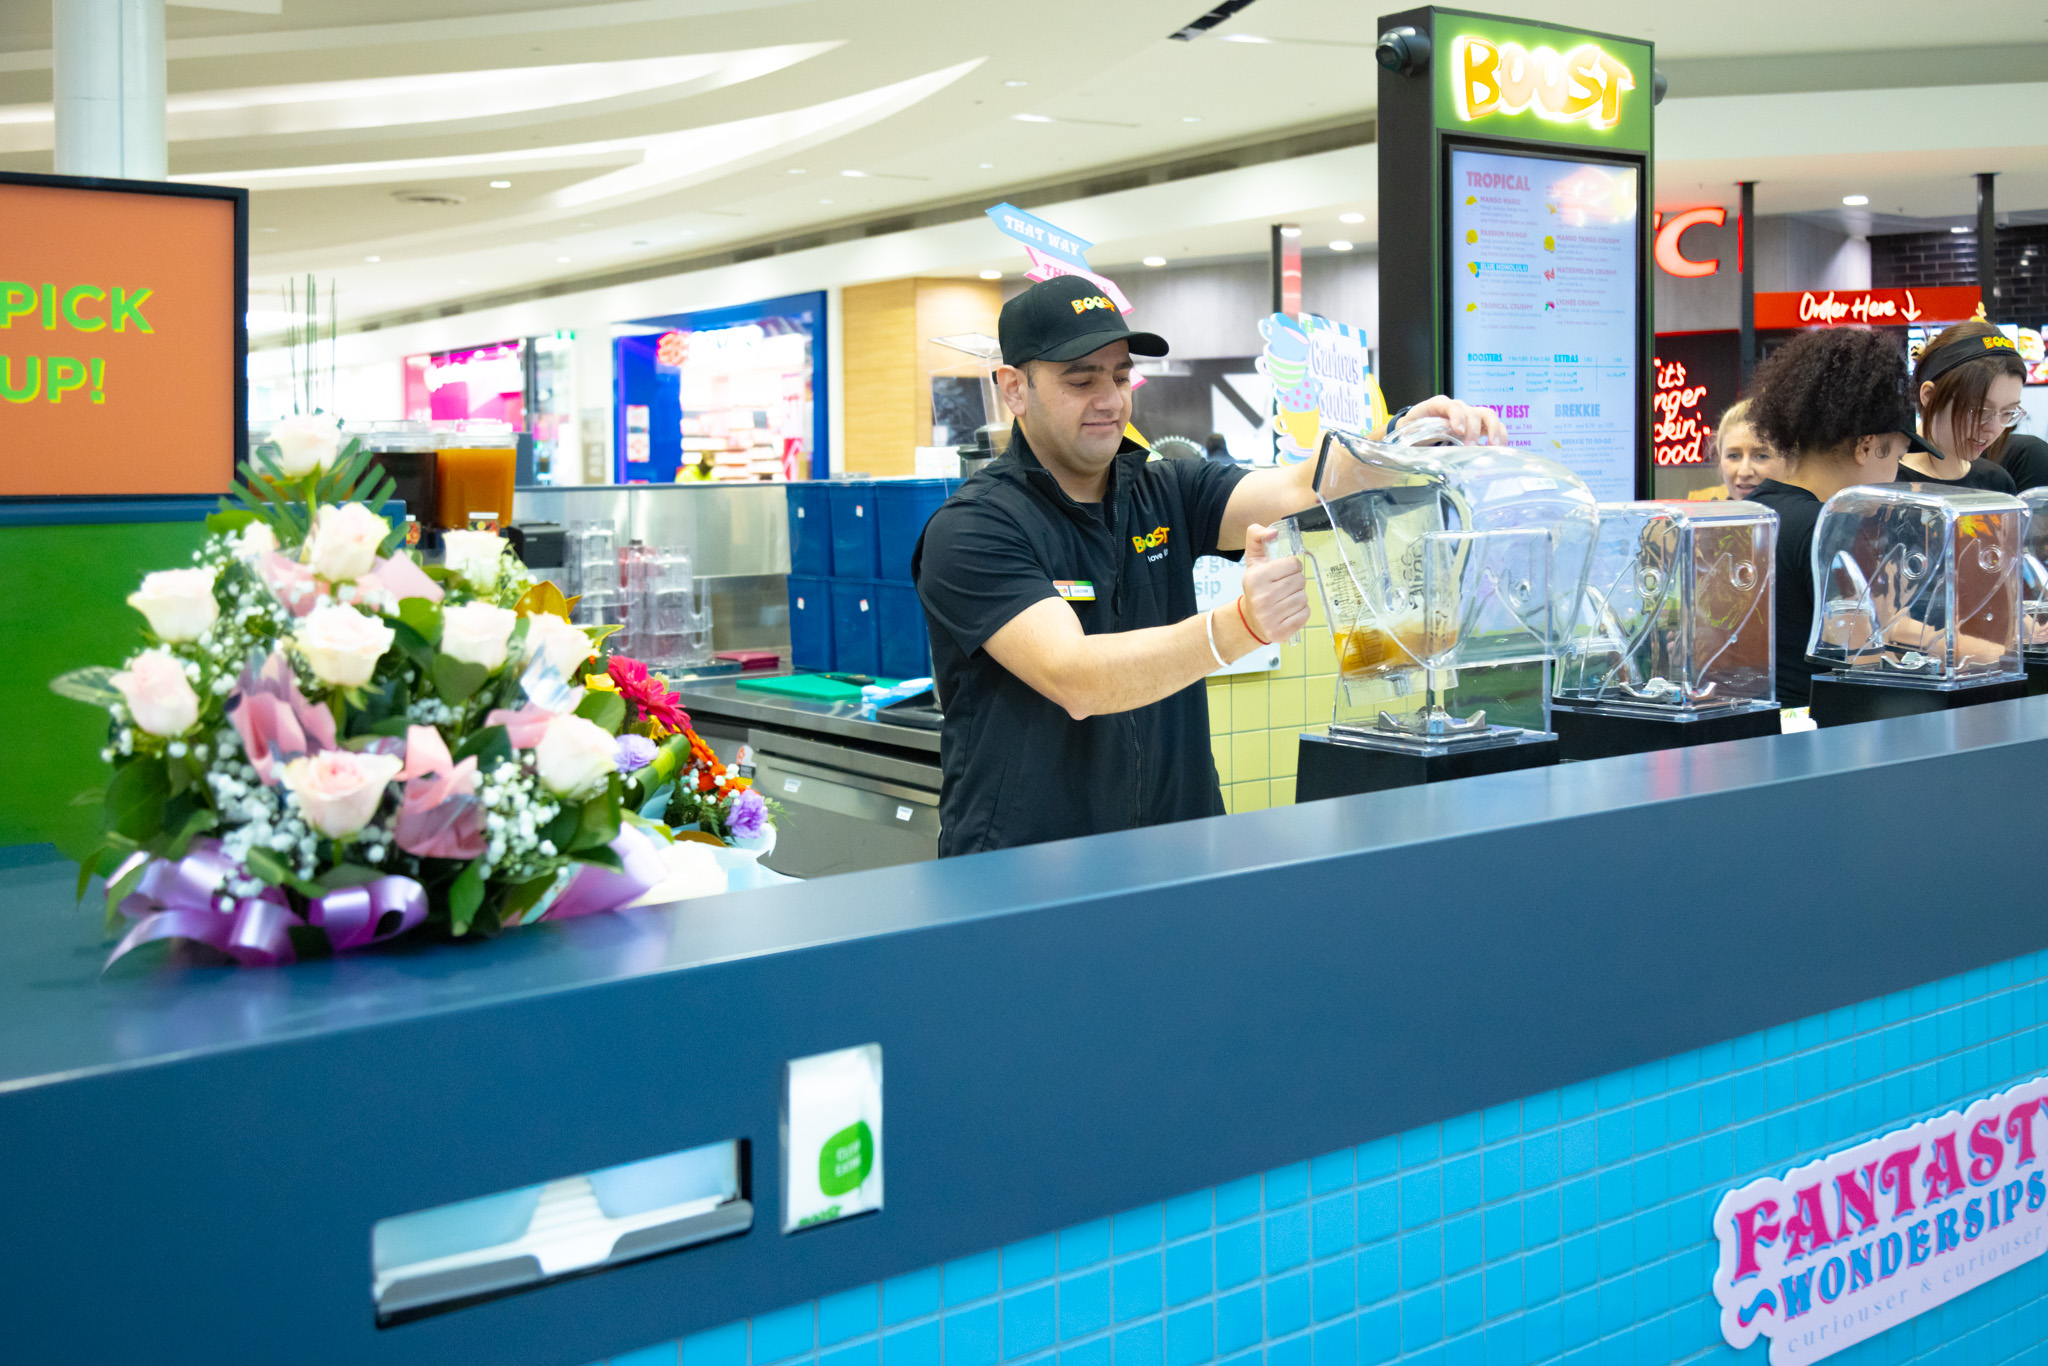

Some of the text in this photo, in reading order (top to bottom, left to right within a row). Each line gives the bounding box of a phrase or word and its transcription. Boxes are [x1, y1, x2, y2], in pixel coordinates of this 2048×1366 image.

[1455, 36, 1636, 128] BOOST
[1466, 171, 1530, 191] TROPICAL
[1003, 214, 1080, 256] THAT WAY
[1043, 263, 1072, 278] TH
[0, 281, 155, 334] PICK
[1799, 290, 1897, 325] Order Here
[1467, 352, 1503, 362] BOOSTERS
[1982, 336, 2017, 353] BOOS
[1554, 354, 1578, 363] EXTRAS
[0, 355, 106, 404] UP!
[1506, 404, 1530, 418] BEST
[1554, 403, 1600, 417] BREKKIE
[1778, 1170, 2047, 1323] WONDERSIPS
[1788, 1225, 2042, 1354] curiouser & curiouser
